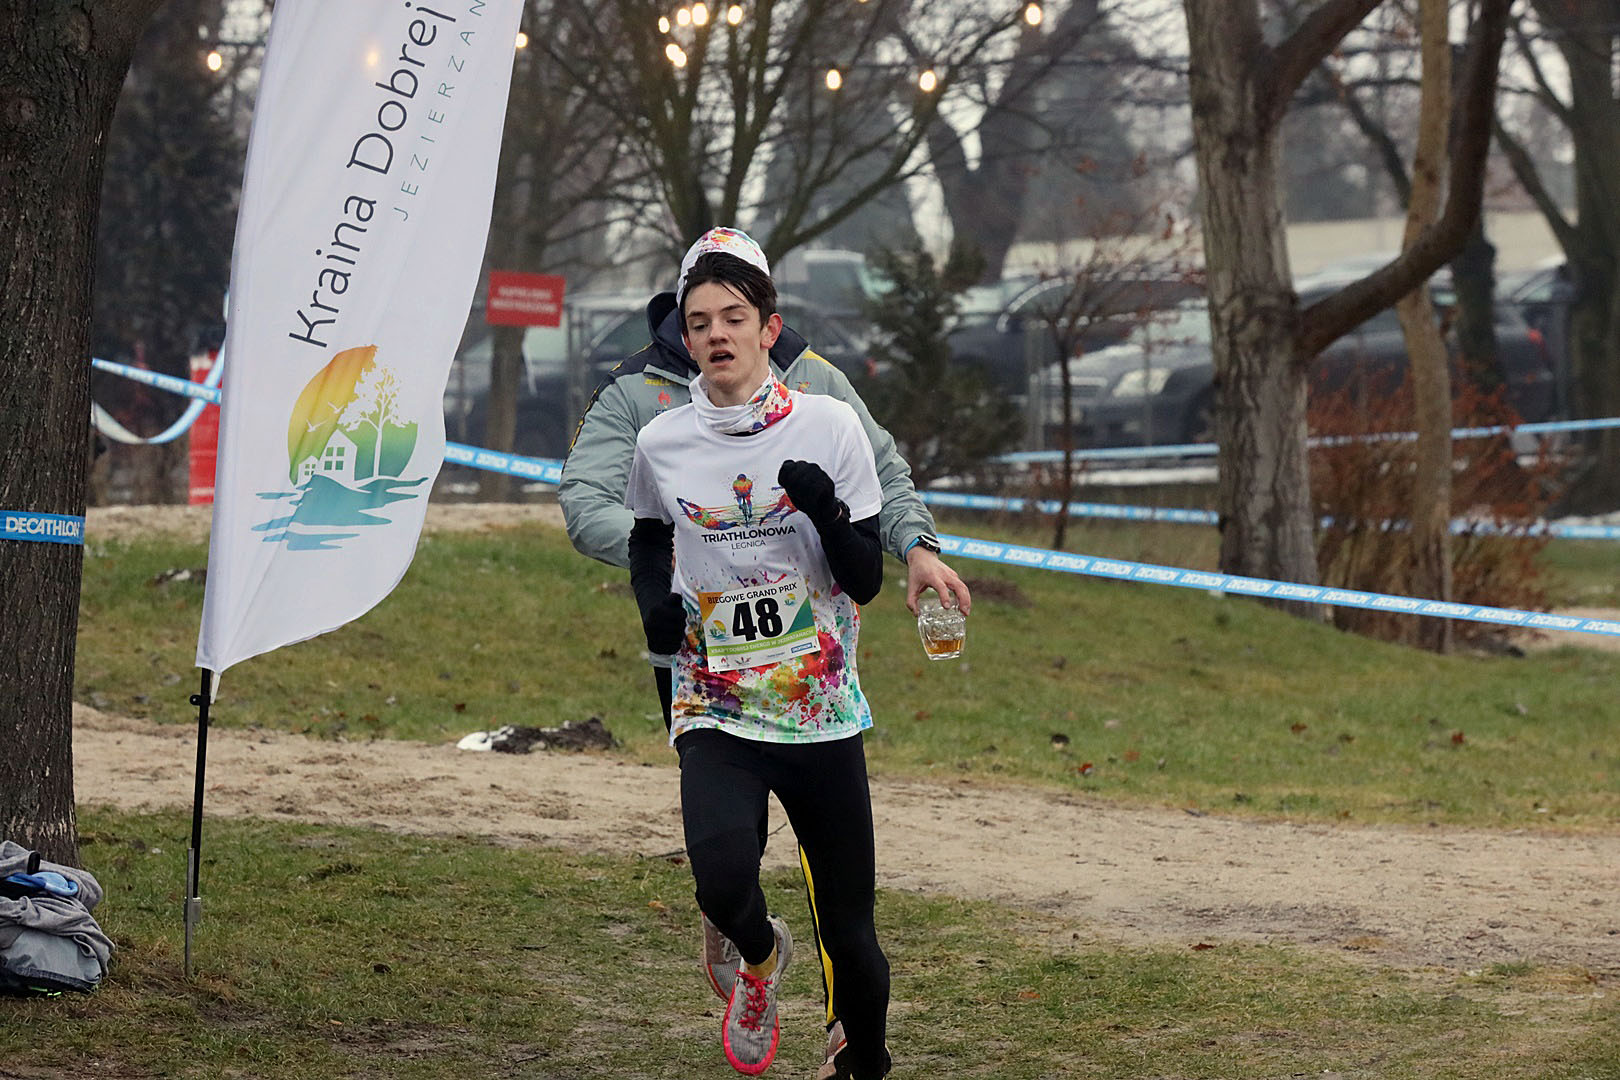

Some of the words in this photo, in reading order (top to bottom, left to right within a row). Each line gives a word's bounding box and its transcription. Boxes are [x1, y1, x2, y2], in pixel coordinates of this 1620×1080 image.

[289, 194, 376, 348] Kraina
[346, 1, 457, 175] Dobrej
[6, 516, 80, 537] DECATHLON
[701, 525, 797, 543] TRIATHLONOWA
[731, 539, 766, 550] LEGNICA
[707, 593, 745, 604] BIEGOWE
[746, 588, 777, 599] GRAND
[779, 582, 798, 593] PRIX
[732, 597, 783, 642] 48
